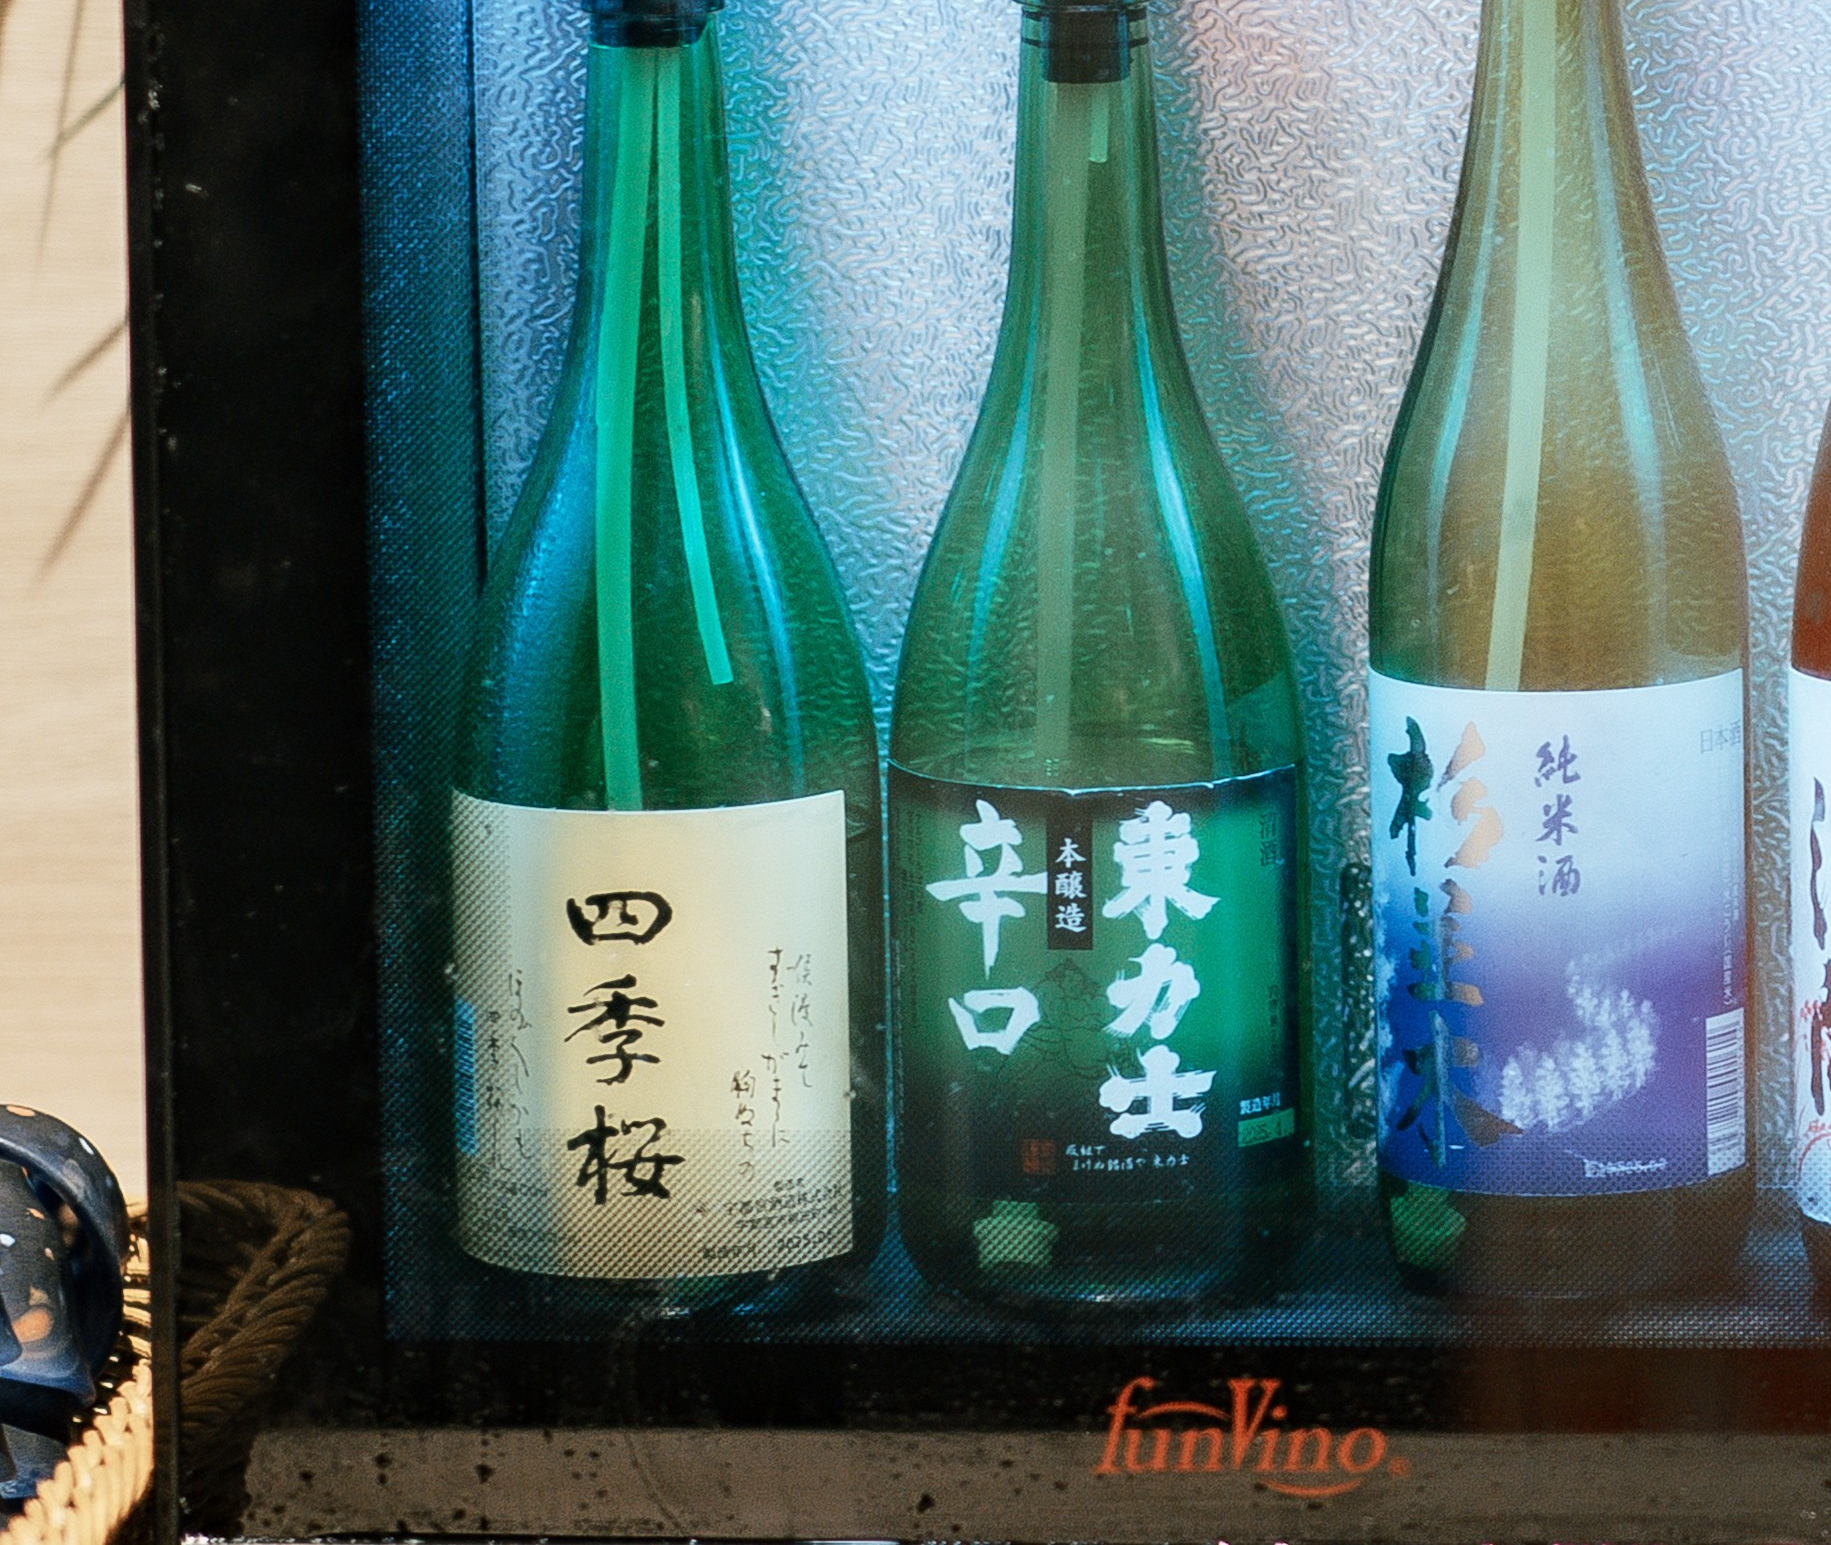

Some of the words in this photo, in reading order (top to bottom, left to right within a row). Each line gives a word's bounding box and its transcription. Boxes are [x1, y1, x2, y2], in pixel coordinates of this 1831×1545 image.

[1053, 837, 1088, 934] 本醸造
[1533, 734, 1584, 897] 純米酒
[926, 798, 1048, 1056] 辛口
[1099, 799, 1221, 1140] 東力士
[564, 891, 687, 1206] 四季桜
[1093, 1375, 1389, 1475] funVino
